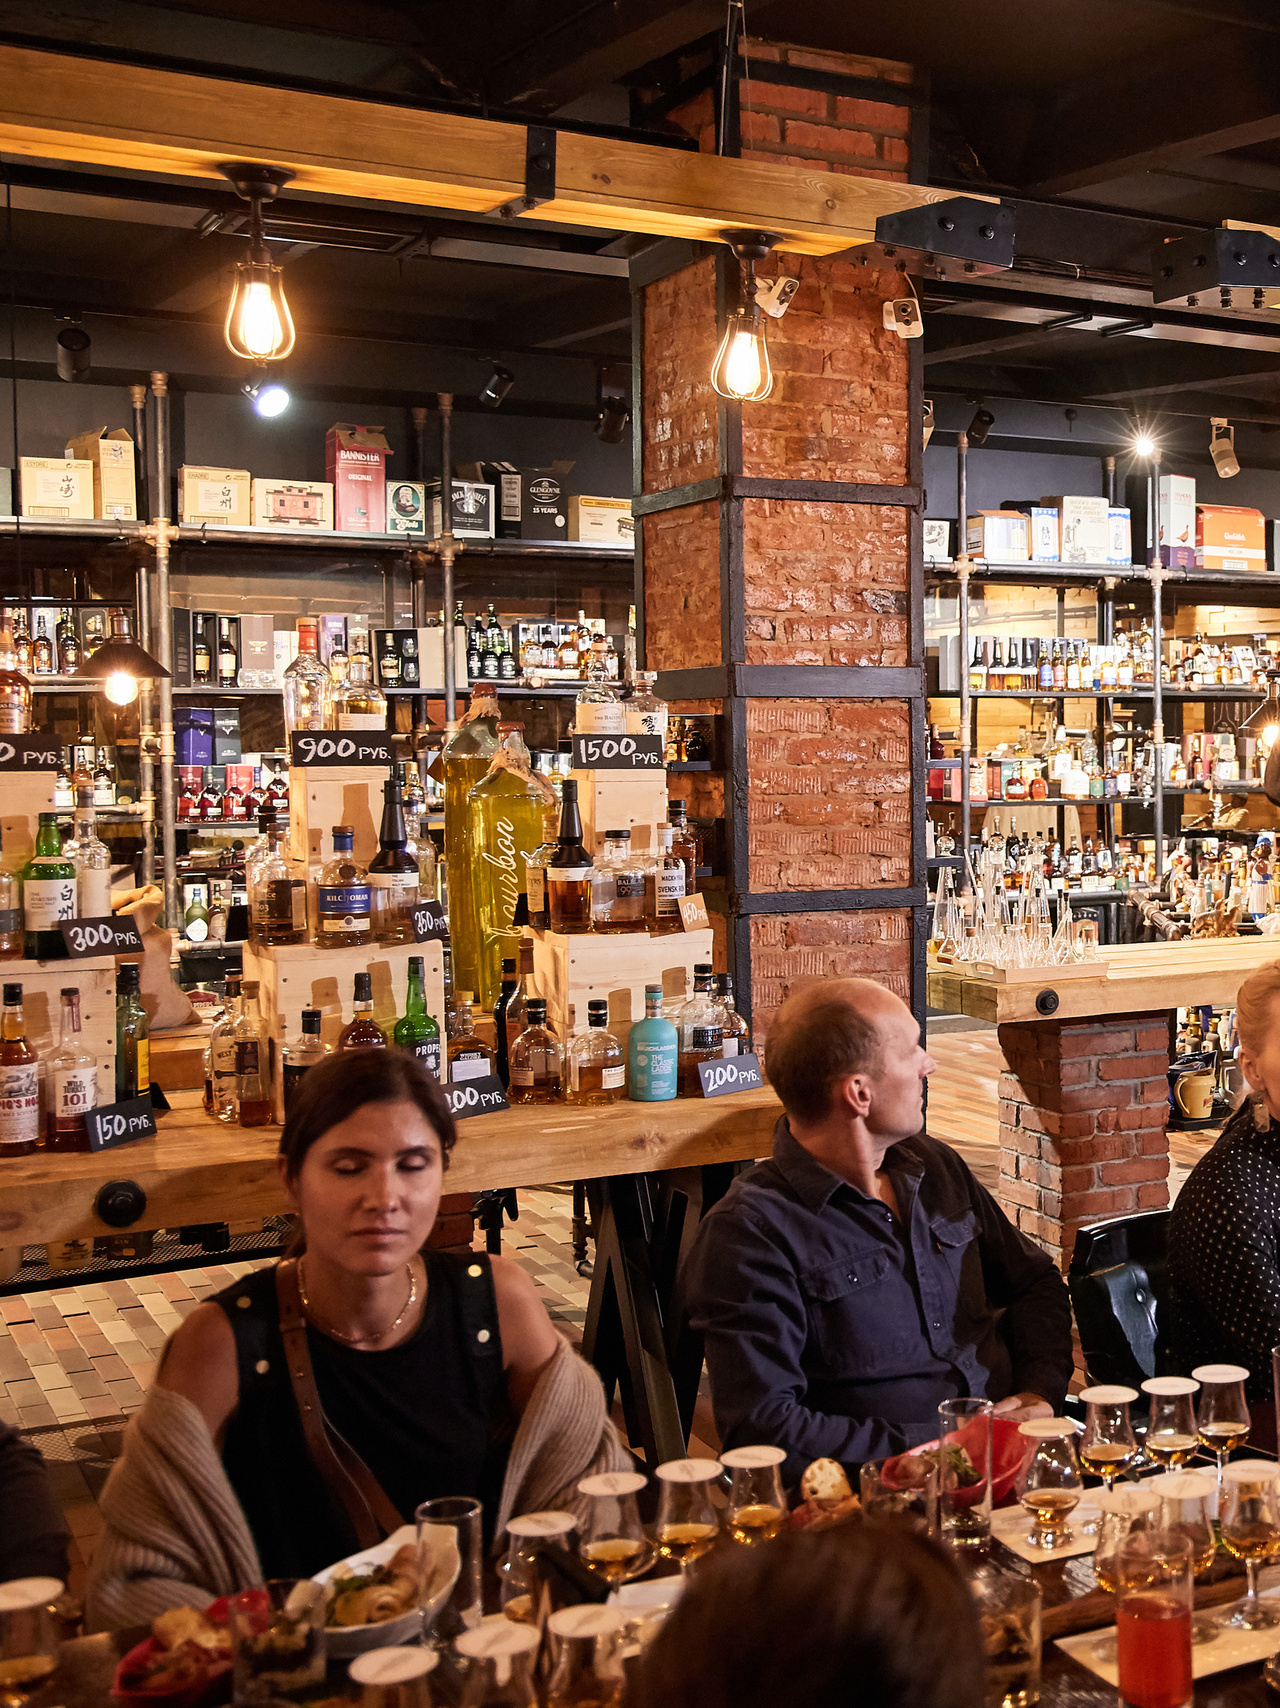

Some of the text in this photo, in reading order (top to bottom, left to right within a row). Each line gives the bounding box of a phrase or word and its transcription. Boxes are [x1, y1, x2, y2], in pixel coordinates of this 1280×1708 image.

[340, 450, 379, 461] BANNISTER
[348, 473, 373, 482] ORIGINAL
[23, 751, 61, 765] РУБ.
[298, 738, 391, 762] 900 РУБ.
[580, 737, 662, 765] 1500 РУБ.
[415, 911, 434, 935] 350
[683, 902, 697, 924] 450
[69, 924, 140, 951] 300 РУБ.
[704, 1064, 760, 1092] 200 РУБ.
[63, 1093, 87, 1106] 101
[481, 1092, 505, 1107] РУБ.
[96, 1114, 152, 1144] 150 РУБ.
